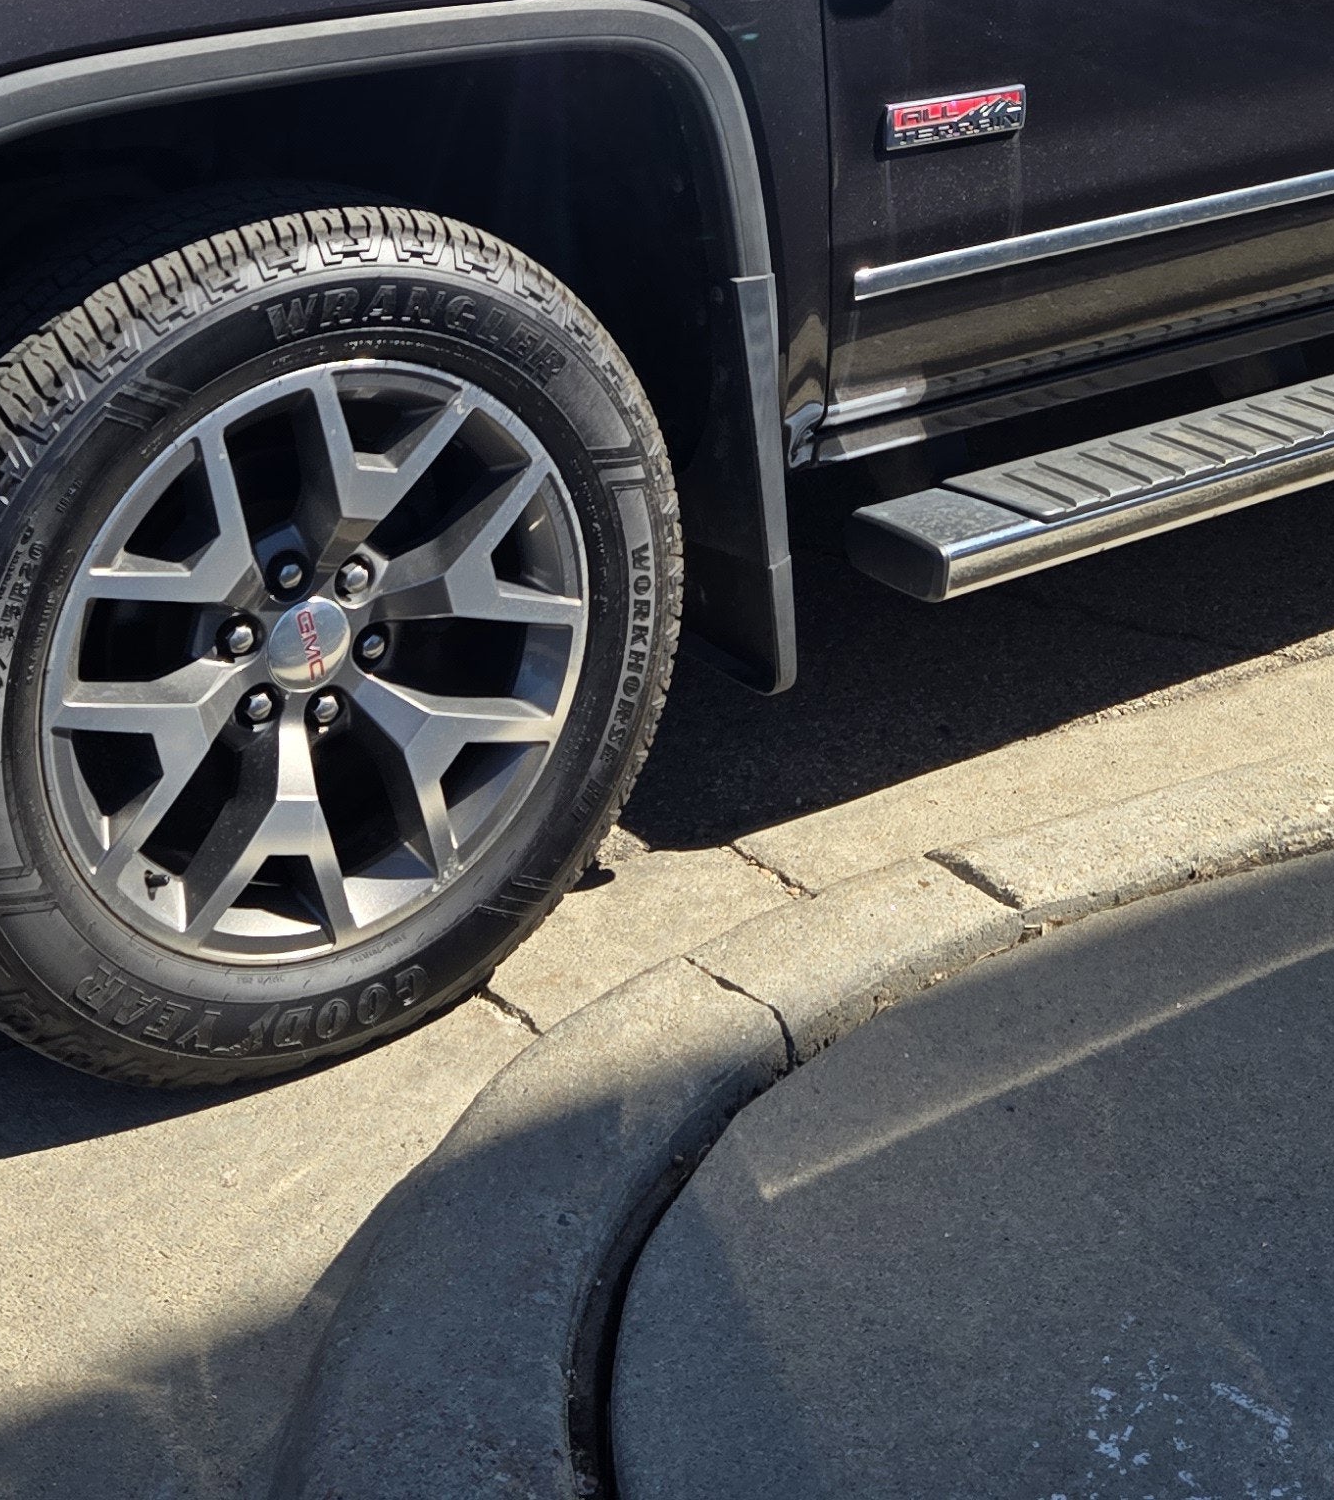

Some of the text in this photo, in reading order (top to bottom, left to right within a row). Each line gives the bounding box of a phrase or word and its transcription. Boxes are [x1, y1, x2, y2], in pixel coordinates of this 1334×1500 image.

[894, 112, 1022, 146] TERRAIN
[901, 106, 960, 126] ALL
[265, 285, 567, 390] WRANGLER
[296, 610, 325, 681] GMC
[599, 542, 651, 768] WORKHORSE
[75, 964, 430, 1056] GOODYEAR
